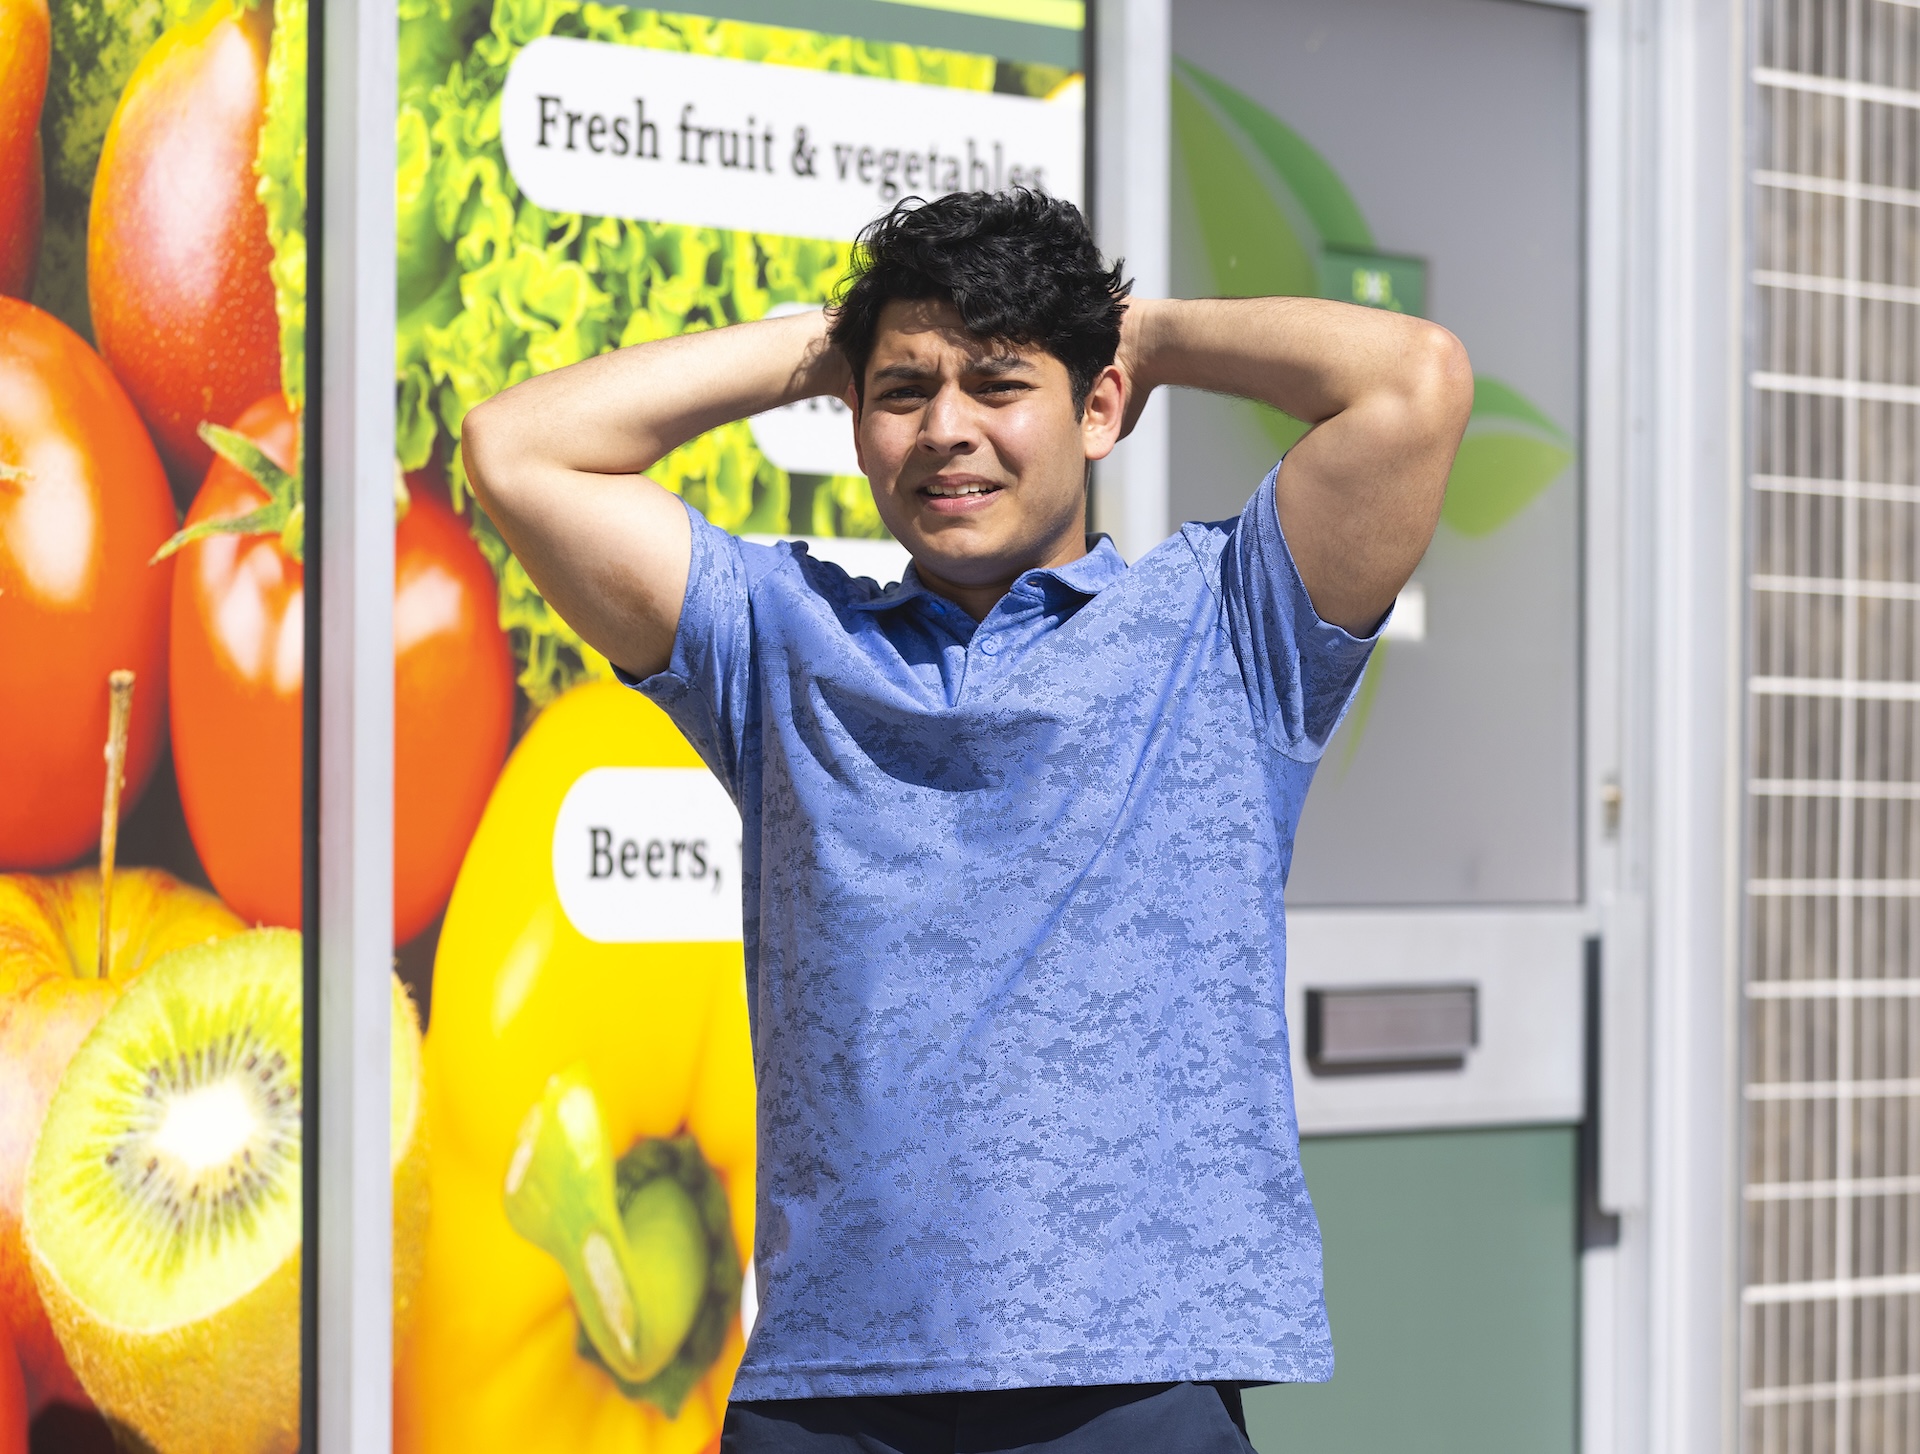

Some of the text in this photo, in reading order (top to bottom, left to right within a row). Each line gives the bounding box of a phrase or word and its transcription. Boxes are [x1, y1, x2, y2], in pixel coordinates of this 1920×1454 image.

[536, 94, 661, 161] Fresh
[677, 102, 775, 174] fruit
[790, 125, 817, 177] &
[588, 825, 722, 896] Beers,
